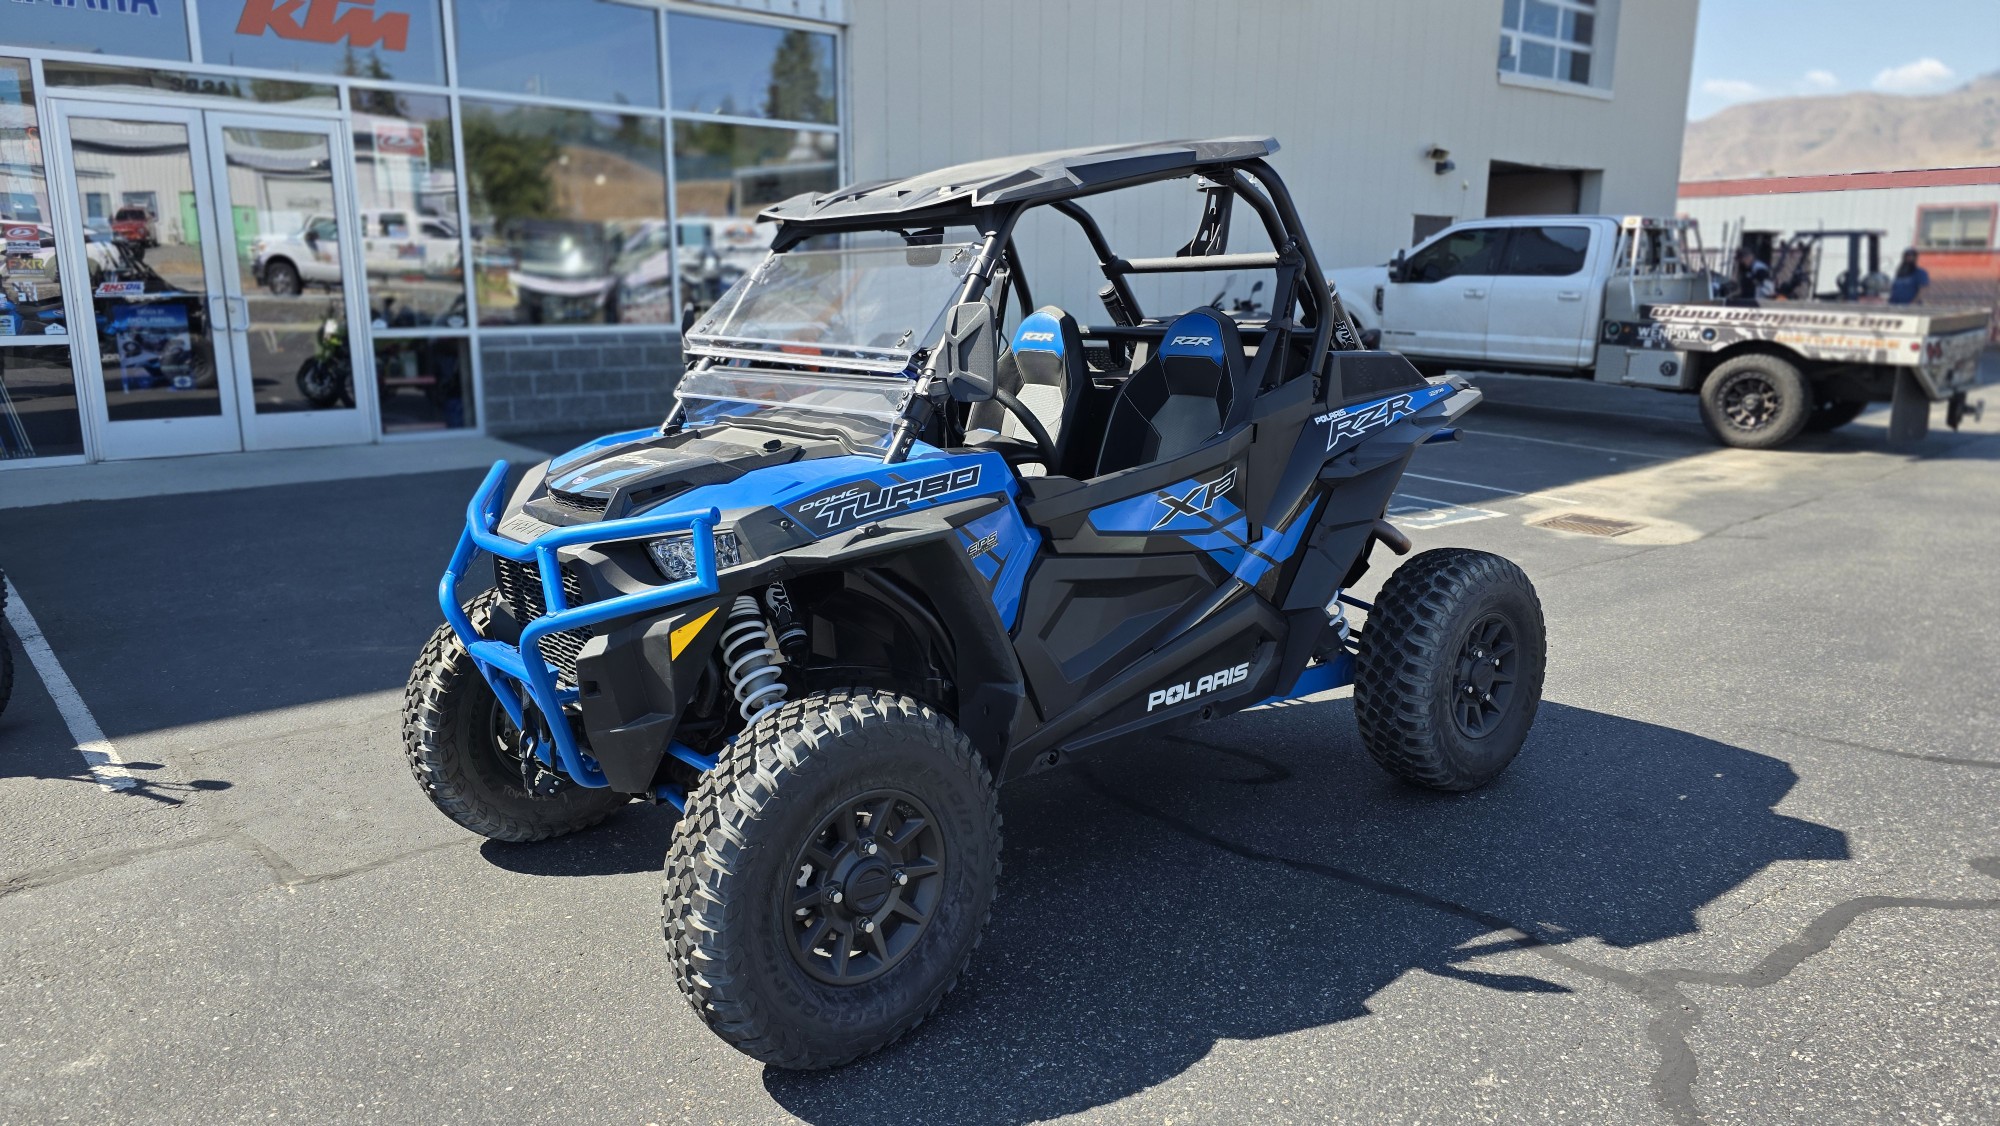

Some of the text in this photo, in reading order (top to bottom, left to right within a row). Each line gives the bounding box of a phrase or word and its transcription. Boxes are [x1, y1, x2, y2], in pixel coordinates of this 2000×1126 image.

[8, 259, 44, 270] FXR
[101, 282, 142, 292] AMSOIL
[1650, 305, 1903, 331] www.wenpow.com
[1020, 331, 1055, 343] RZR
[1170, 335, 1213, 347] RZR
[1637, 326, 1700, 341] WENPOW
[1314, 408, 1347, 425] POLARIS
[1326, 393, 1416, 452] RZR
[798, 486, 860, 513] DOHC
[815, 464, 982, 528] TURBO
[1150, 467, 1237, 531] XP
[966, 530, 999, 555] EPS
[1147, 661, 1250, 712] POLARIS
